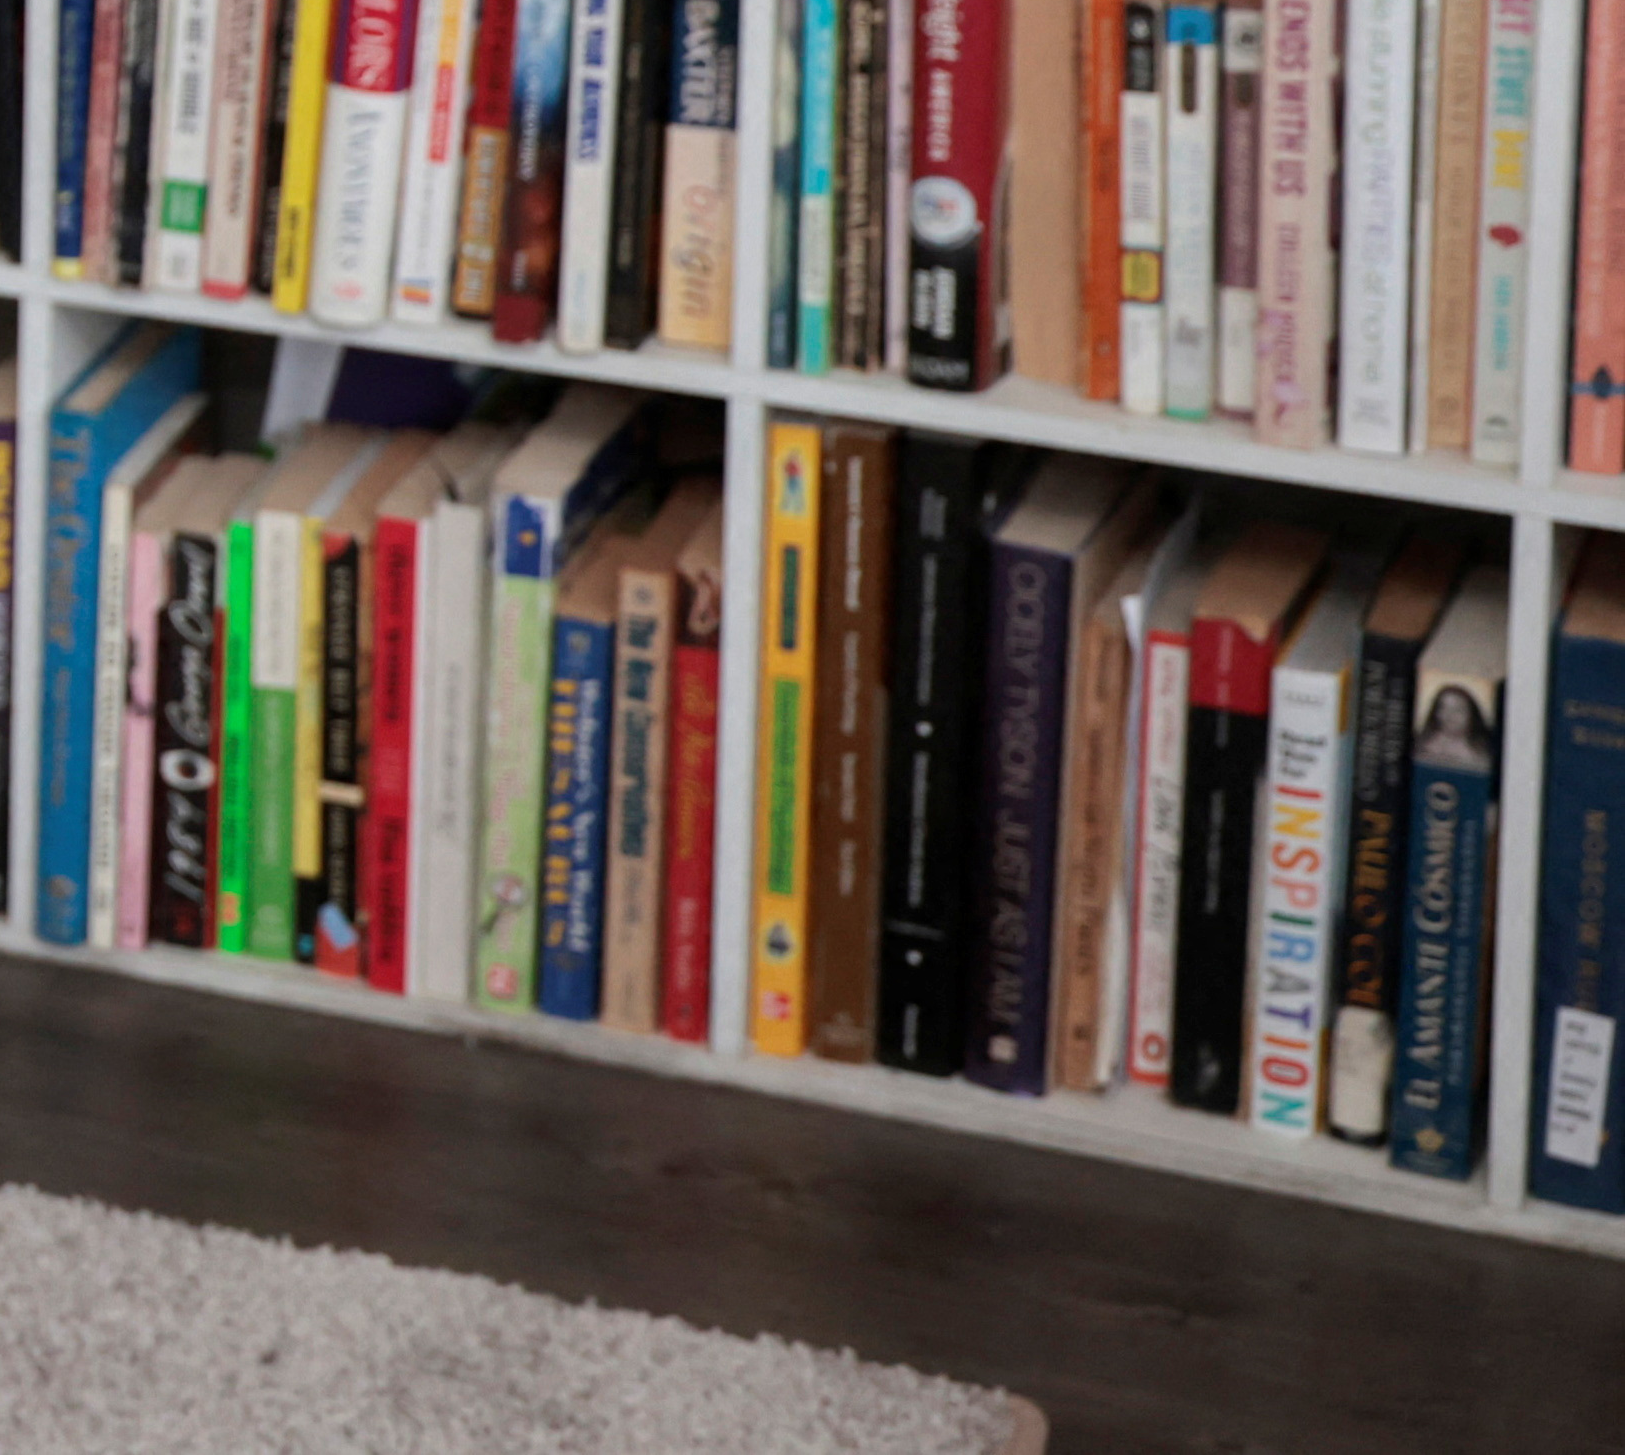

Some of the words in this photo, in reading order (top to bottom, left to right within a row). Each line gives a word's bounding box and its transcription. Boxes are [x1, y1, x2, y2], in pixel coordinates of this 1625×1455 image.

[1277, 0, 1311, 73] ENDS
[1353, 21, 1393, 138] stunning
[928, 70, 953, 163] AMERICA
[1275, 79, 1308, 149] WITH
[337, 108, 383, 268] ANONYMOUS
[1274, 155, 1306, 198] US
[168, 544, 215, 645] Orwell
[627, 615, 658, 650] The
[1005, 563, 1047, 677] CICELY
[165, 645, 213, 747] George
[330, 668, 352, 713] BUT
[625, 658, 655, 701] New
[577, 679, 600, 806] Webster's
[1000, 684, 1041, 797] TYSON
[1356, 659, 1384, 801] PORTOBELLO
[163, 791, 208, 905] 1984
[573, 813, 596, 862] New
[992, 808, 1034, 891] JUST
[1352, 808, 1392, 925] PAULO
[1579, 810, 1607, 946] MOSCOW
[569, 872, 594, 952] World
[990, 901, 1029, 944] AS
[1261, 785, 1324, 1129] INSPIRATION
[986, 968, 1025, 1024] AM
[1347, 934, 1386, 1009] COE
[1409, 939, 1451, 1059] AMANTE
[1405, 1066, 1440, 1110] EL
